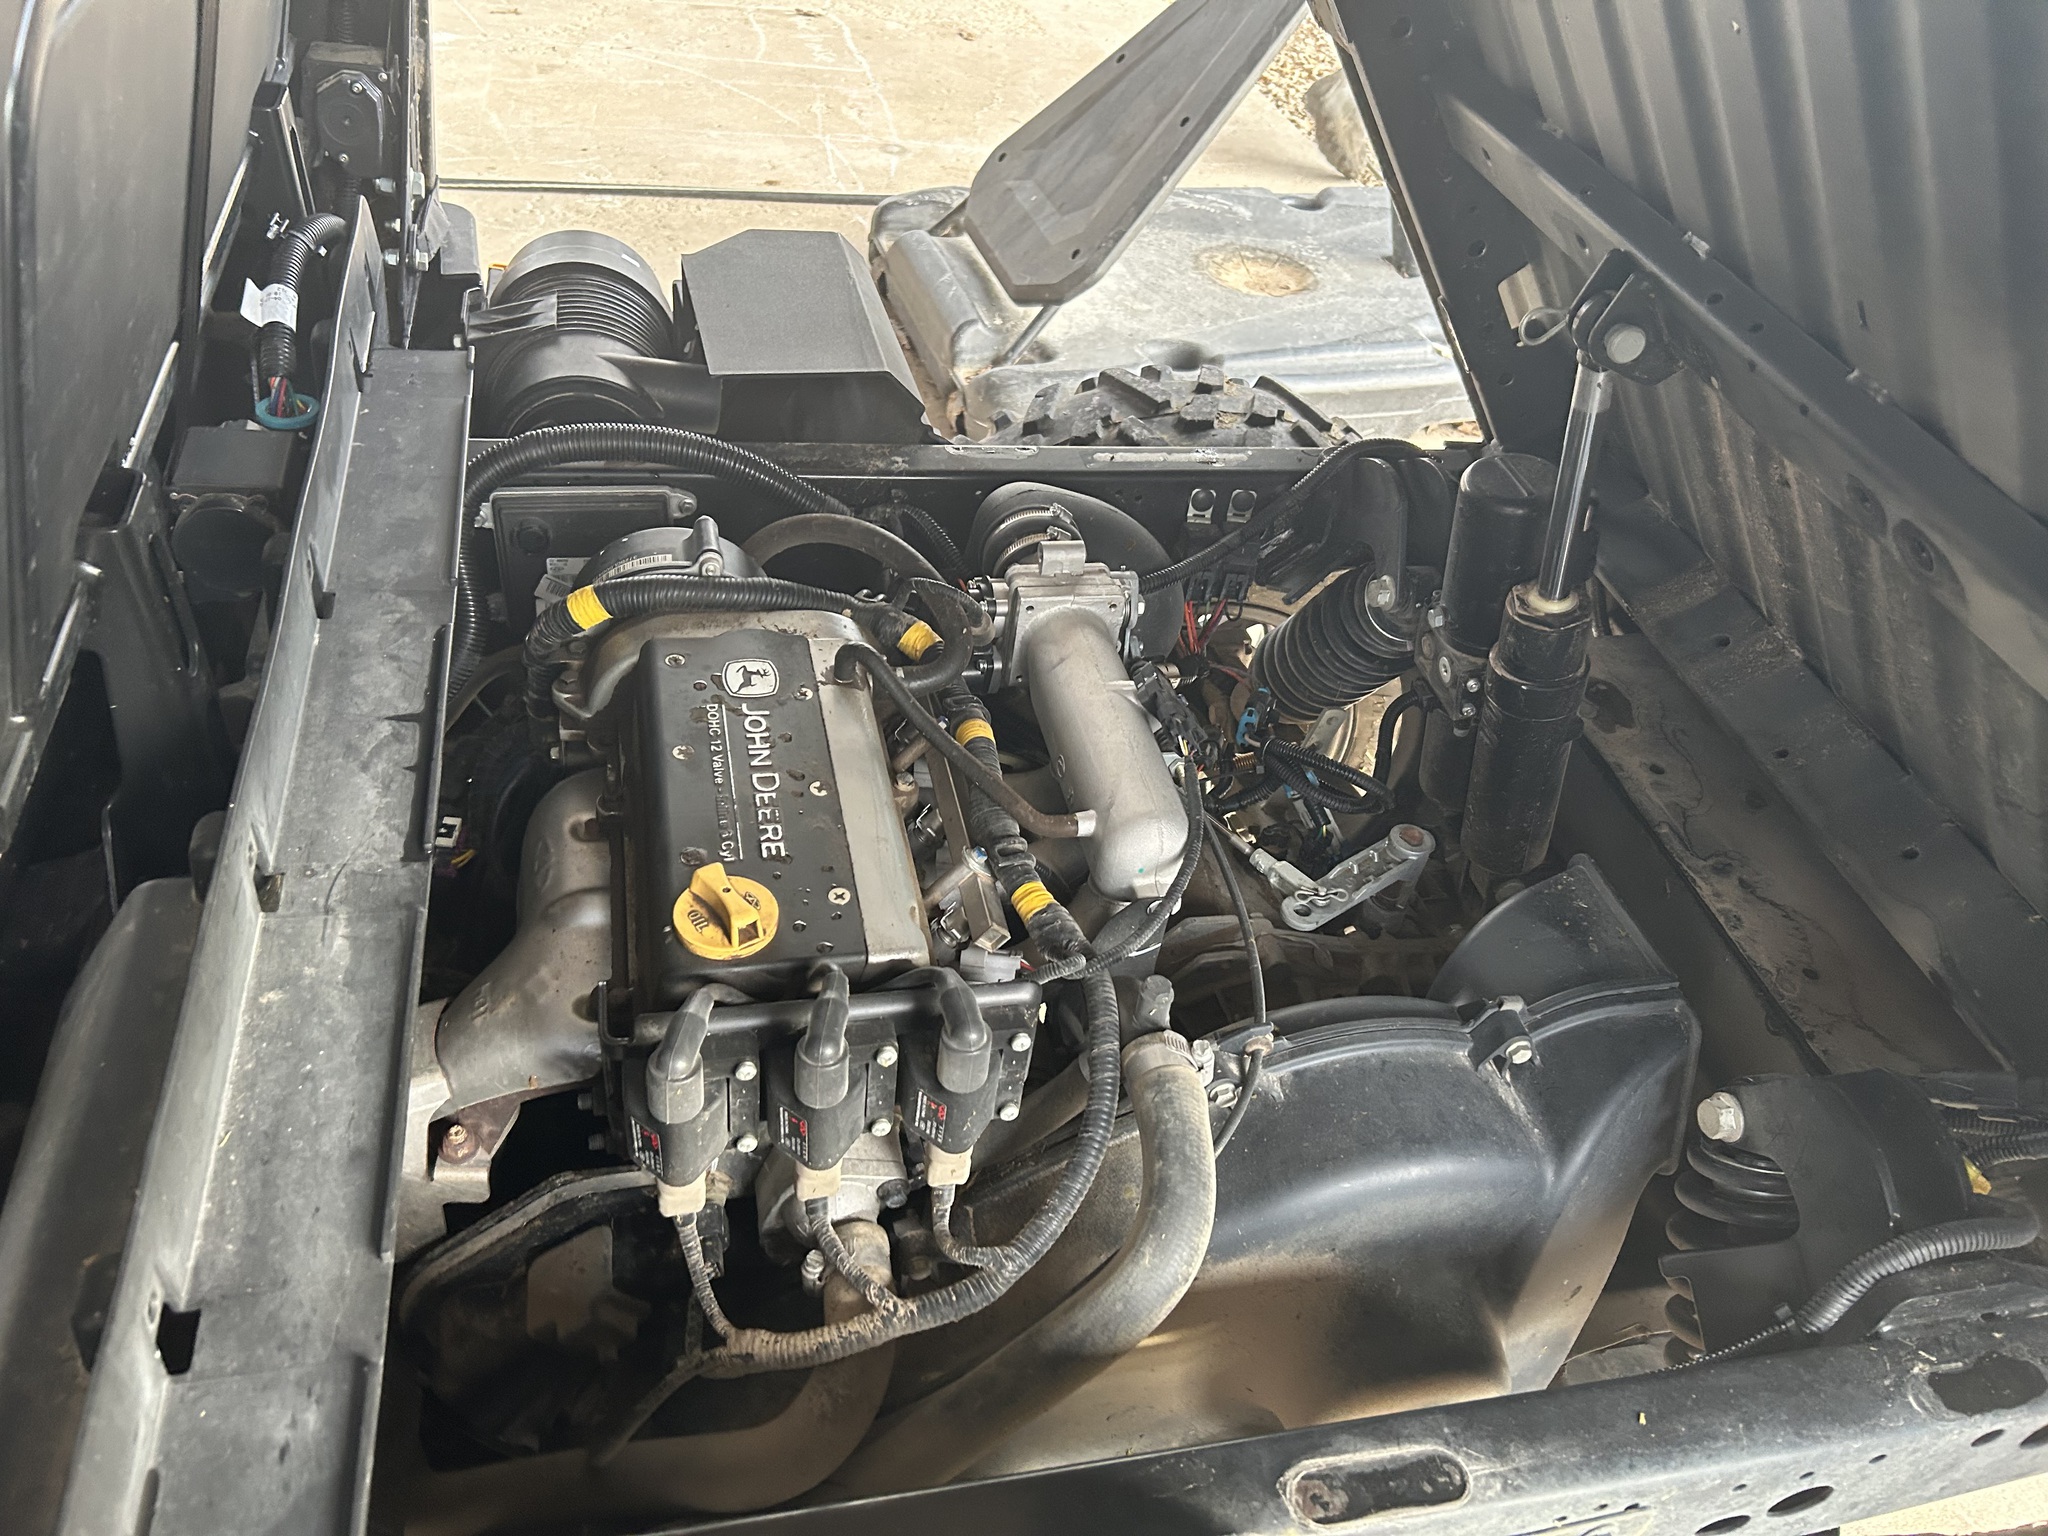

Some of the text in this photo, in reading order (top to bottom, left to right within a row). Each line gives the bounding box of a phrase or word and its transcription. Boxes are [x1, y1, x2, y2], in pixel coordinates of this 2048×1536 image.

[706, 703, 721, 736] DOHC
[710, 741, 722, 752] 12
[712, 754, 725, 784] Valve
[742, 703, 786, 858] JOHN DEERE
[719, 841, 735, 862] Cyl
[687, 909, 709, 933] OIL
